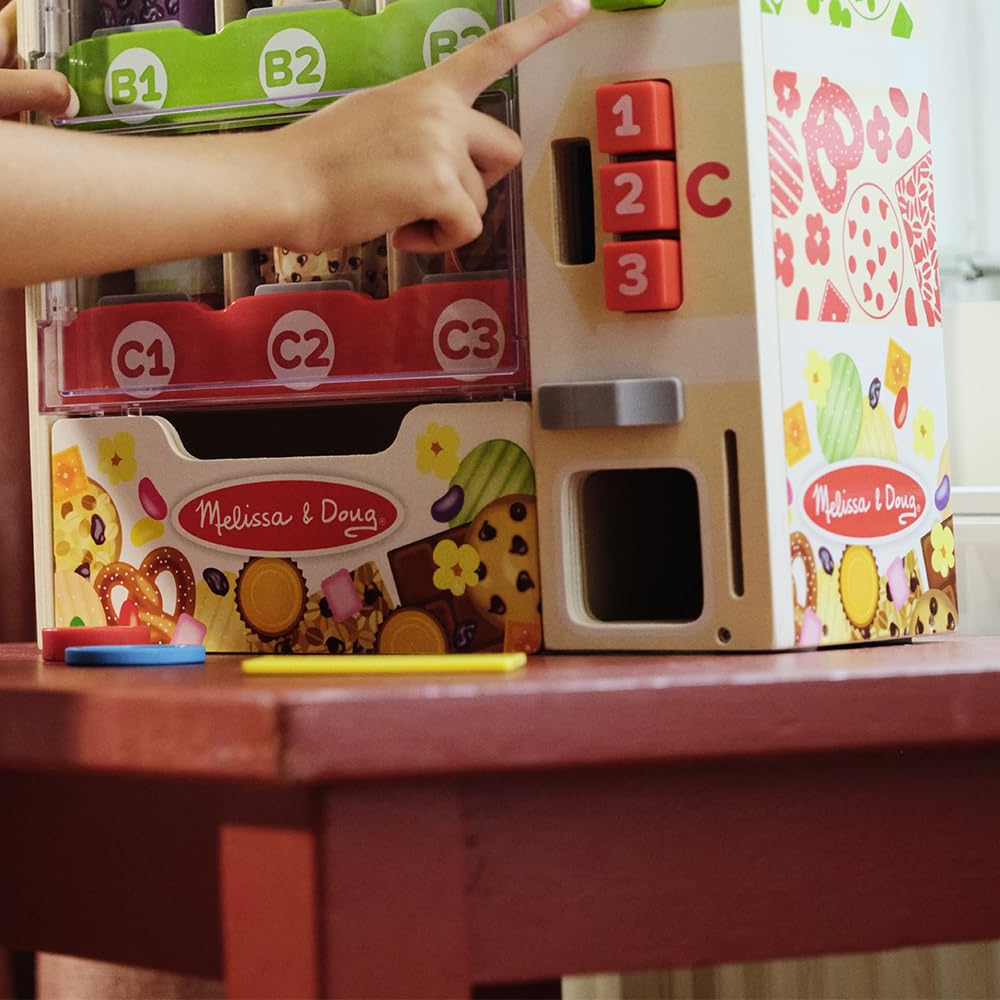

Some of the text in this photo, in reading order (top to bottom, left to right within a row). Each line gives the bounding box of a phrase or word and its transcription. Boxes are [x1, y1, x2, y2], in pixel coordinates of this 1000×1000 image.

[264, 46, 321, 88] B2
[430, 26, 487, 66] B
[110, 64, 162, 105] B1
[612, 94, 641, 137] 1
[614, 172, 645, 215] 2
[686, 161, 733, 219] C
[618, 253, 649, 297] 3
[116, 338, 170, 378] C1
[271, 329, 330, 369] C2
[437, 318, 500, 360] C3
[195, 498, 378, 538] Melissa & Doug
[812, 482, 872, 525] Melissa
[885, 483, 918, 525] Doug
